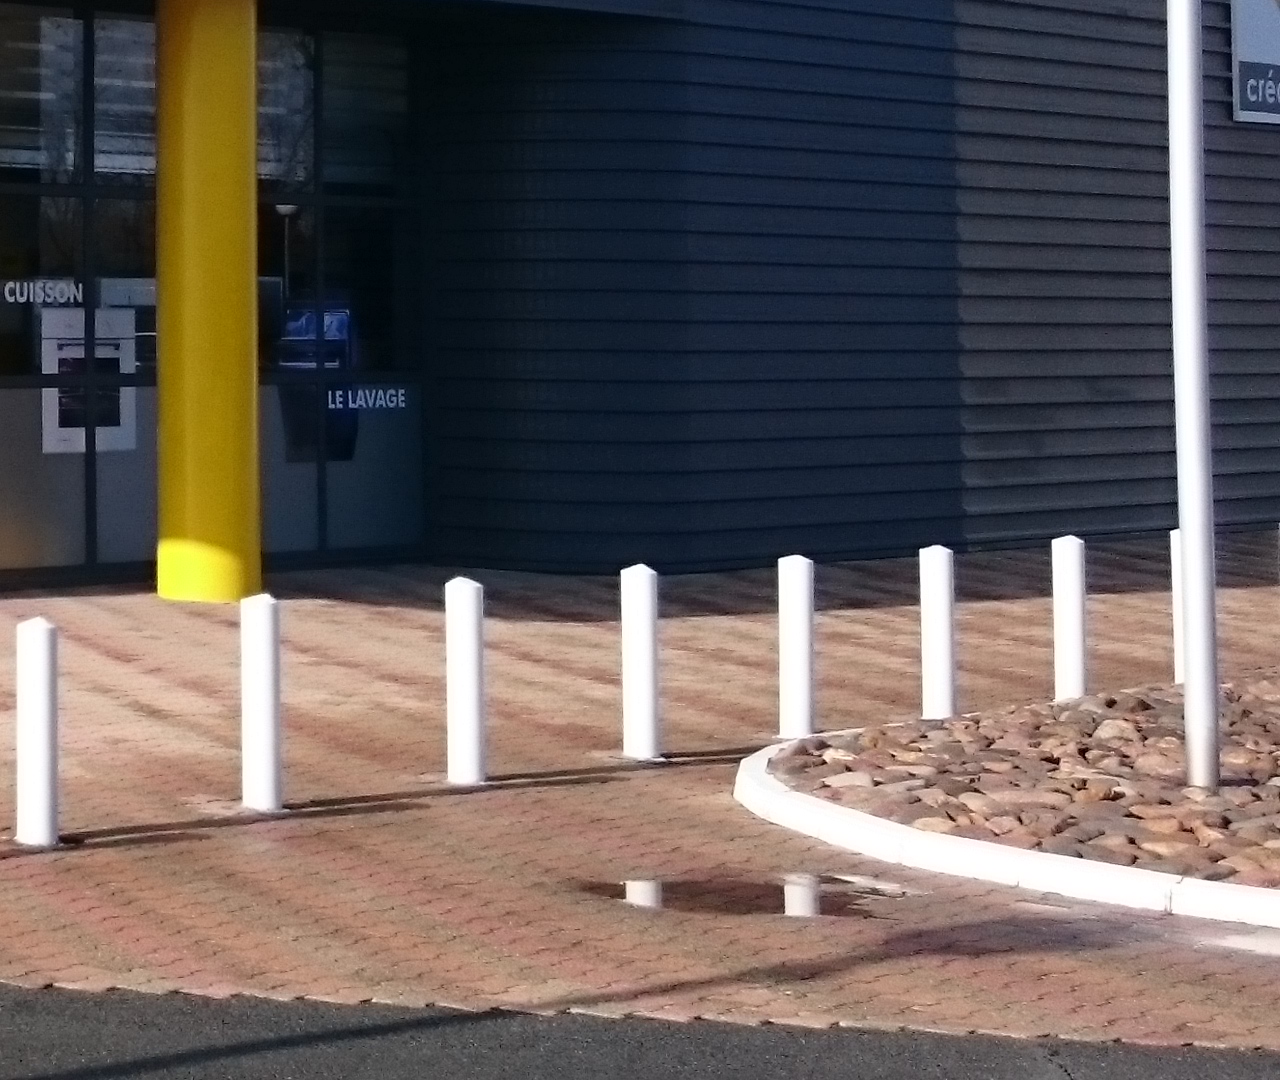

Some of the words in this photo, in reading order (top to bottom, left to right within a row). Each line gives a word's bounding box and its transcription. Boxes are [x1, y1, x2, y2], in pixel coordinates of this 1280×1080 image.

[1246, 69, 1280, 104] cré
[3, 281, 84, 304] CUISSON
[327, 391, 344, 409] LE
[348, 389, 407, 409] LAVAGE
